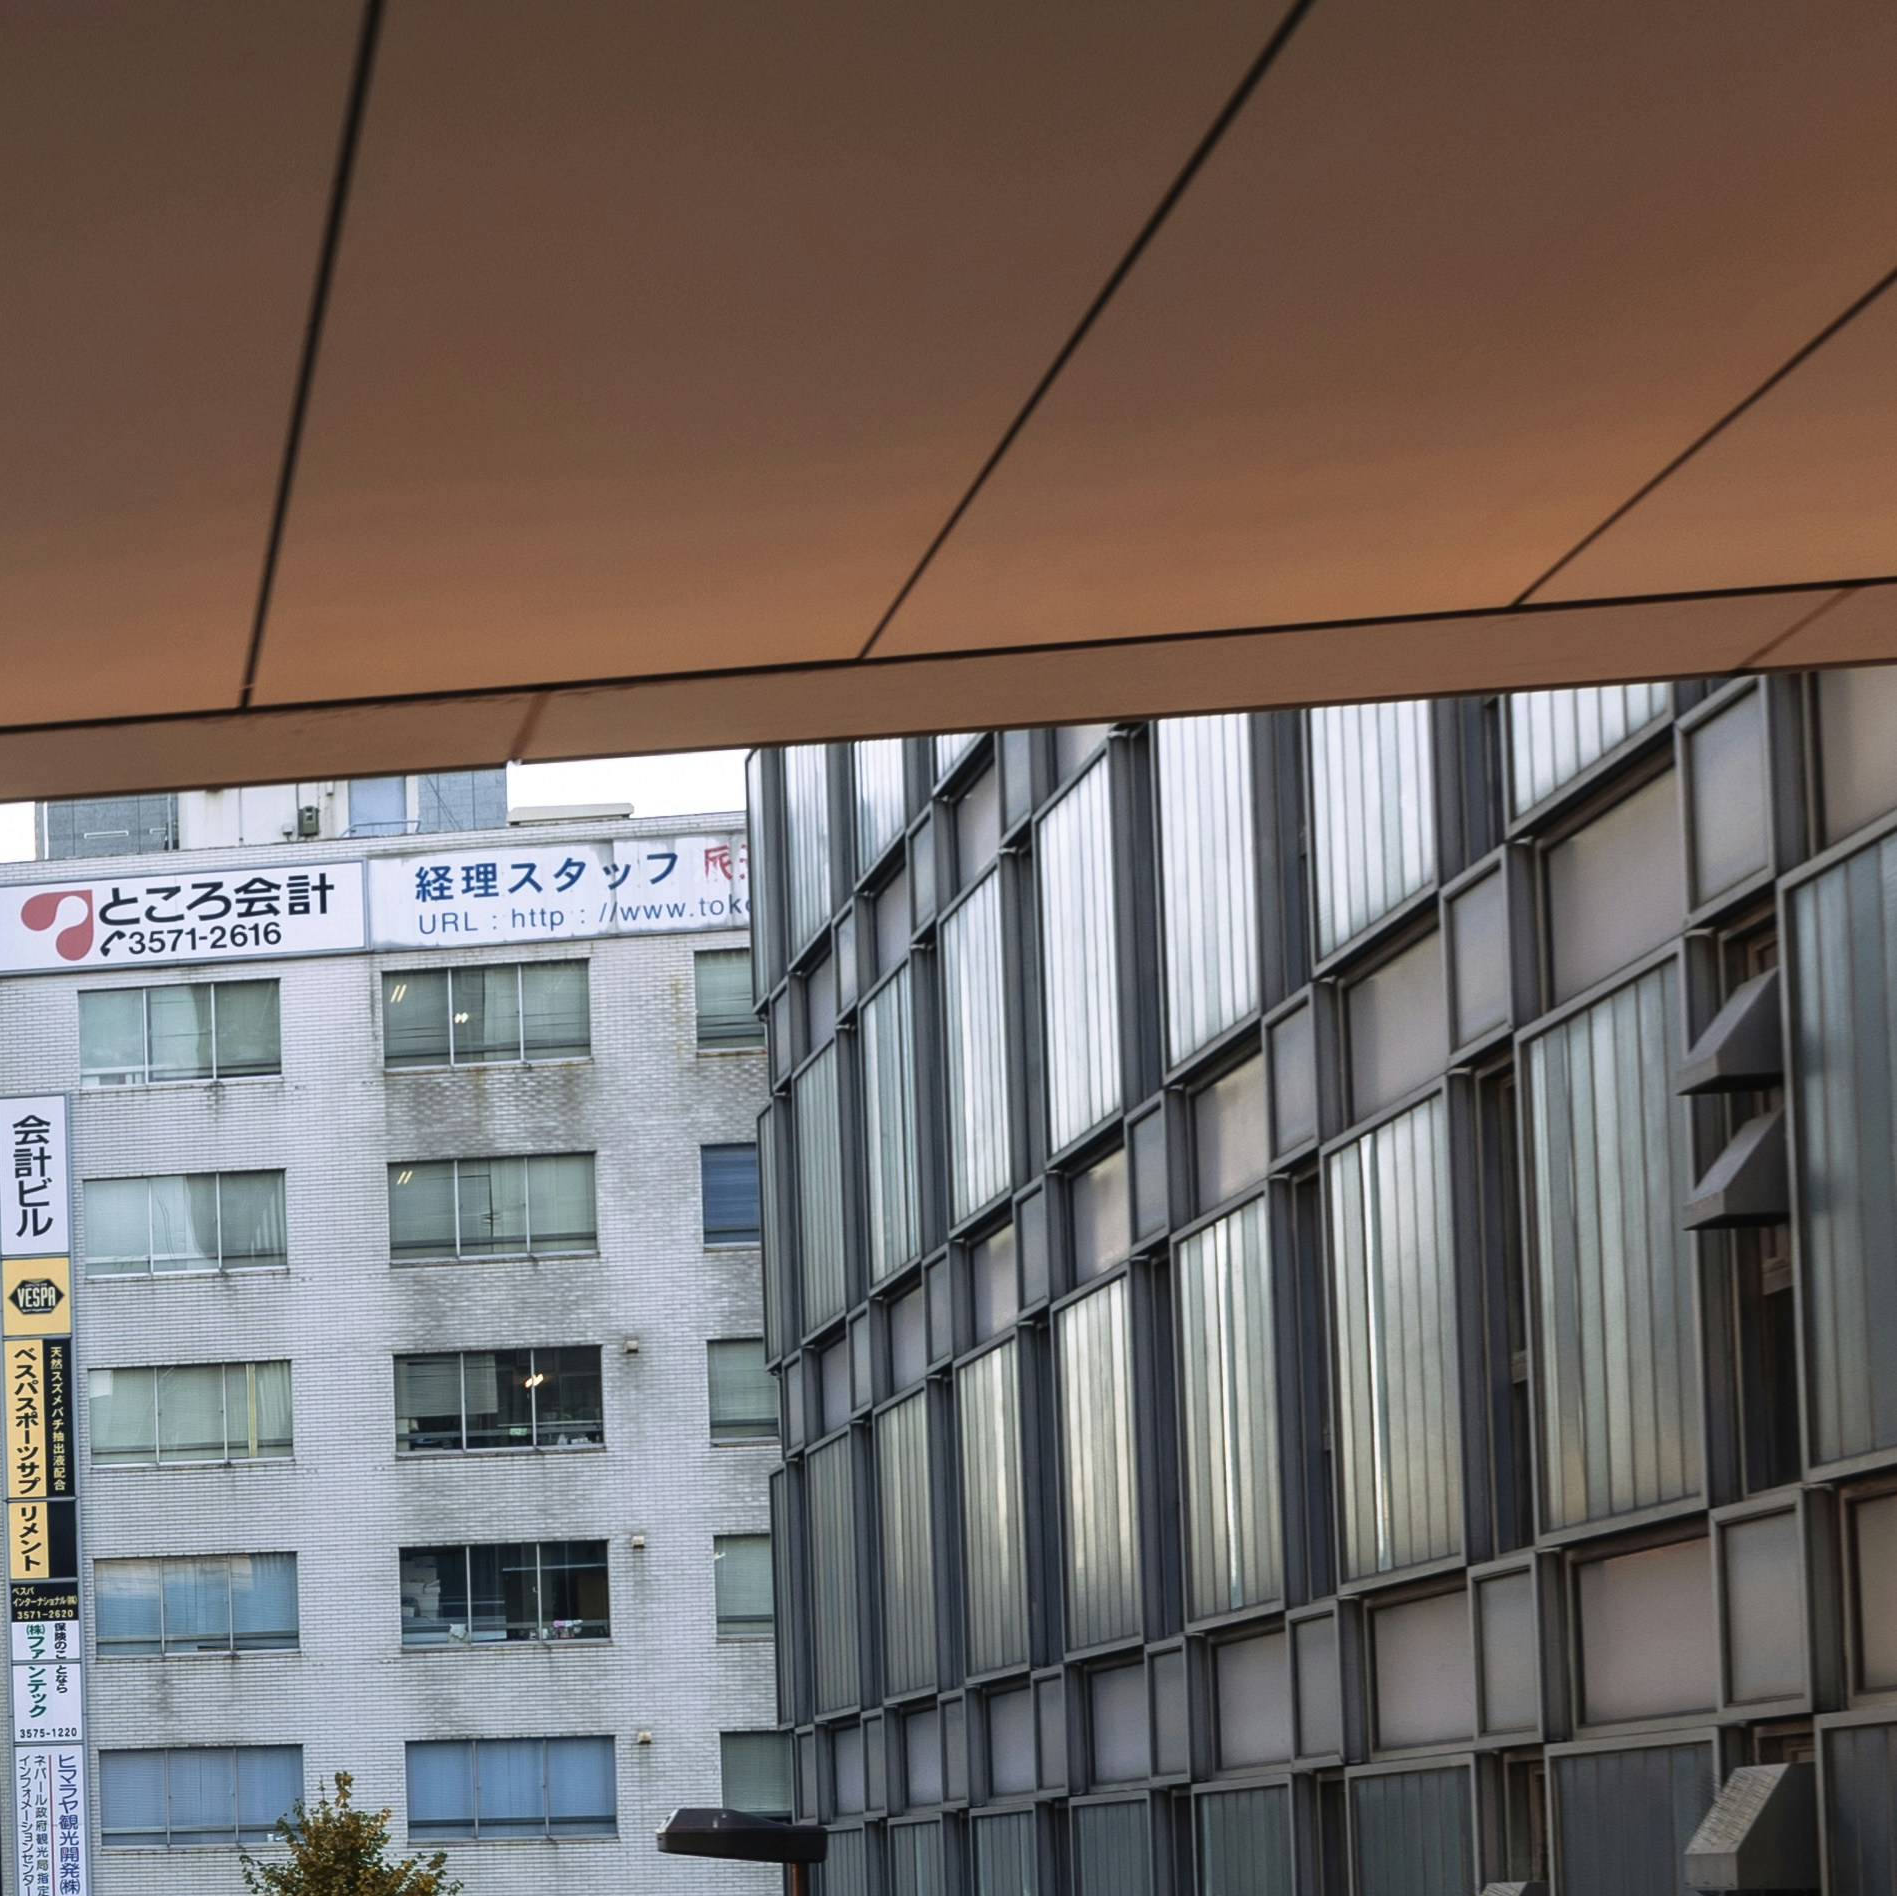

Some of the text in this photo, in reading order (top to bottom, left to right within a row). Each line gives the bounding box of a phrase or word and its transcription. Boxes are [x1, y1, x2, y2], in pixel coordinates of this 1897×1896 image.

[414, 852, 678, 903] 経理スタッフ
[99, 873, 335, 926] ところ会計
[127, 921, 282, 956] 3571-2616
[418, 911, 479, 935] URL
[511, 908, 565, 931] http
[12, 1114, 54, 1238] 会計ビル
[17, 1286, 56, 1308] VESPA
[17, 1609, 74, 1620] 3571-2620
[54, 1622, 69, 1694] 保険のことなら
[19, 1727, 78, 1739] 3575-1220
